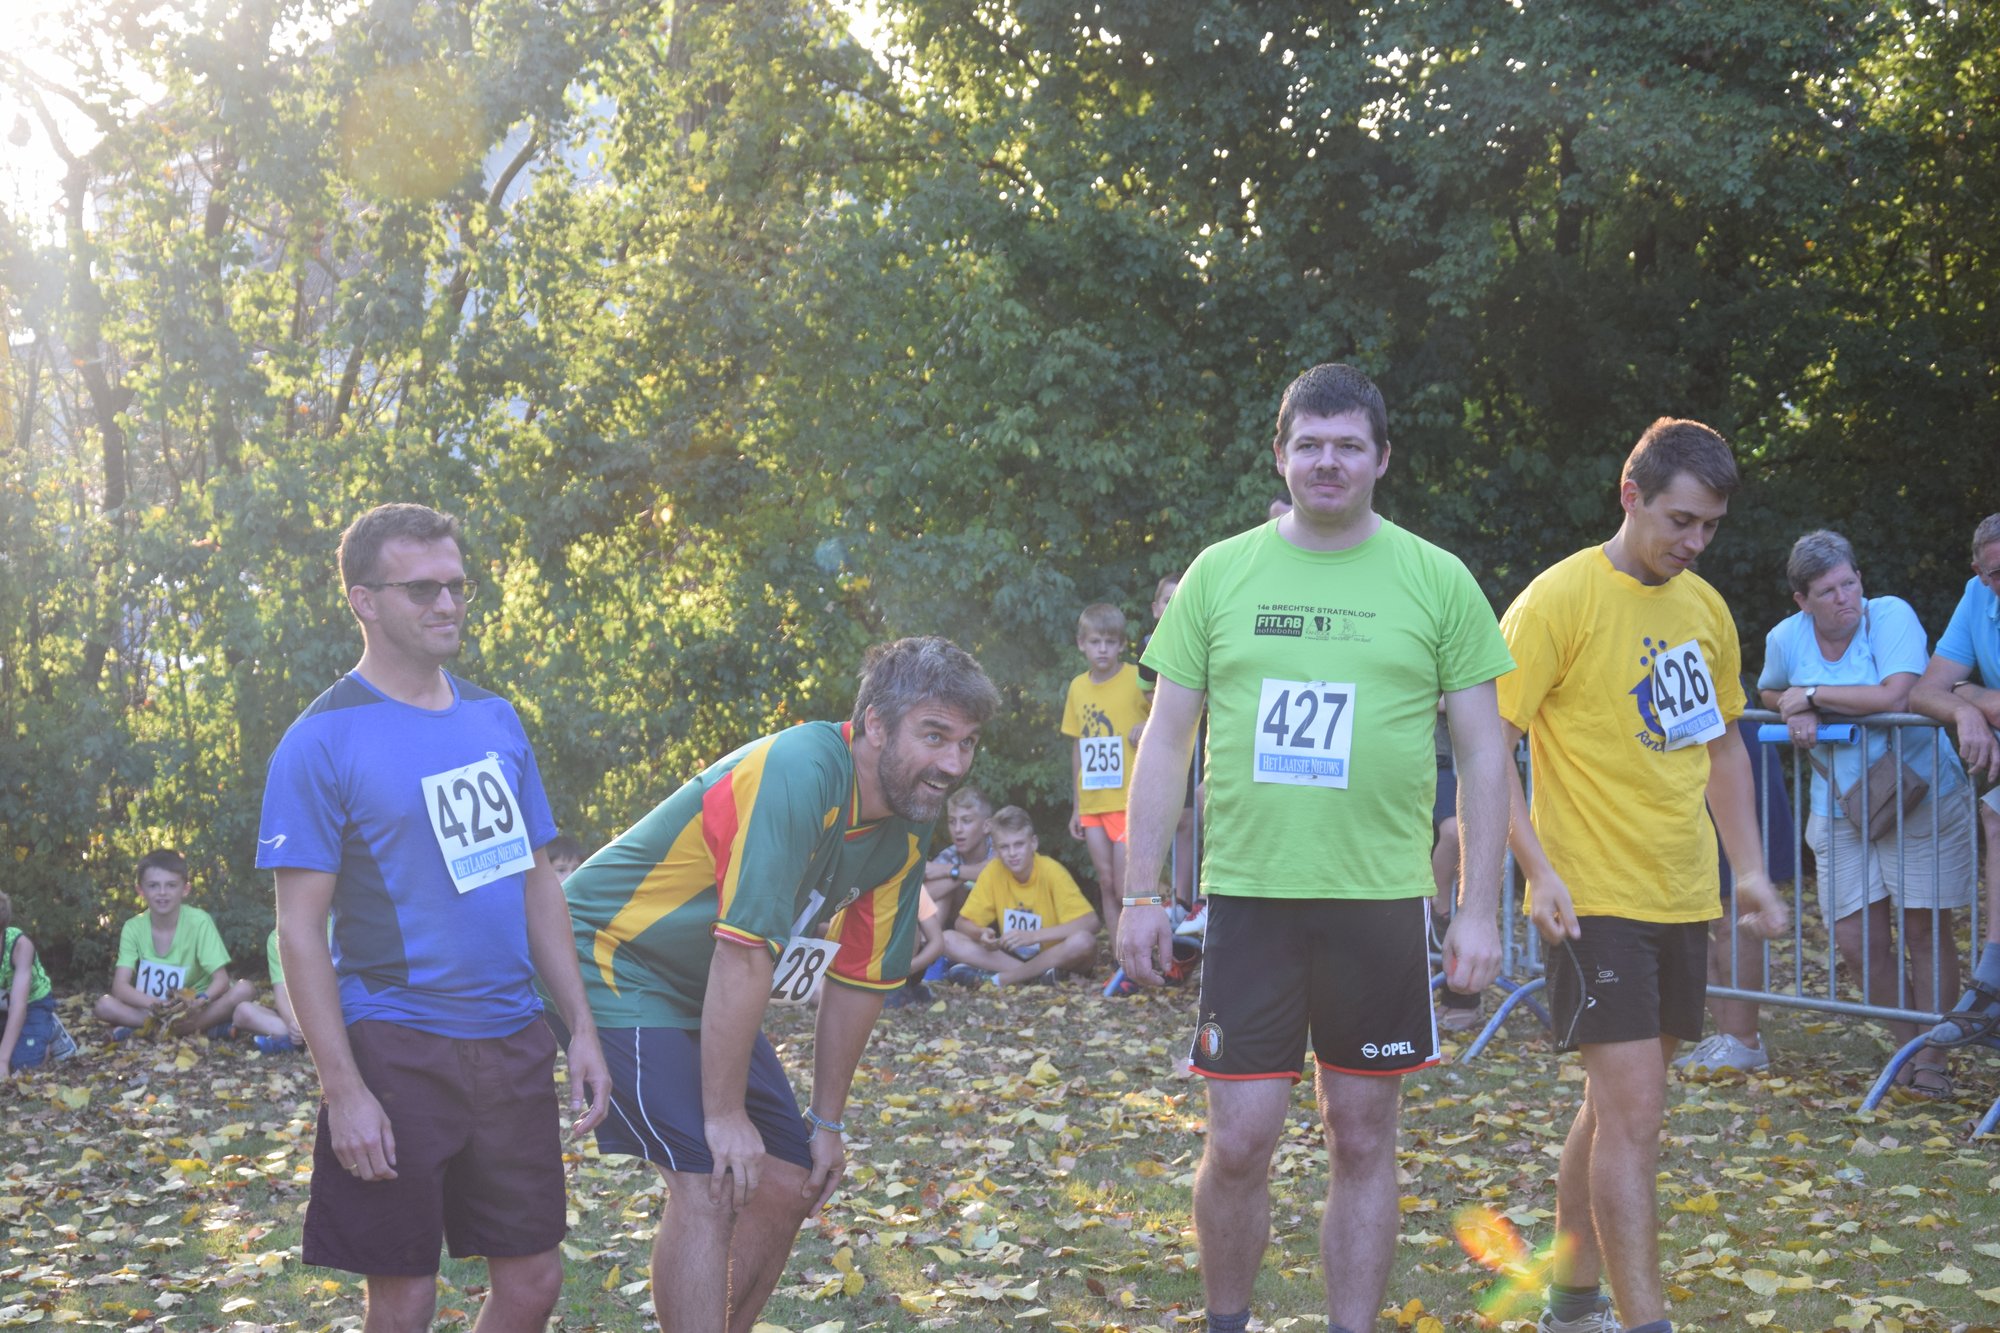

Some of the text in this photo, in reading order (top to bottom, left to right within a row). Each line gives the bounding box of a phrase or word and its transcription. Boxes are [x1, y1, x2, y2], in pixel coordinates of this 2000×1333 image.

[1257, 616, 1302, 629] FITLAB
[1271, 604, 1315, 613] BRECHTSE
[1317, 607, 1376, 619] STRATENLOOP
[1655, 650, 1709, 718] 426
[1262, 689, 1348, 750] 427
[1085, 743, 1120, 772] 255
[1263, 755, 1340, 775] HET LAATSTE NIEUWS
[436, 771, 514, 848] 429
[141, 966, 180, 997] 139
[769, 946, 826, 1001] 28
[1381, 1041, 1416, 1057] OPEL
